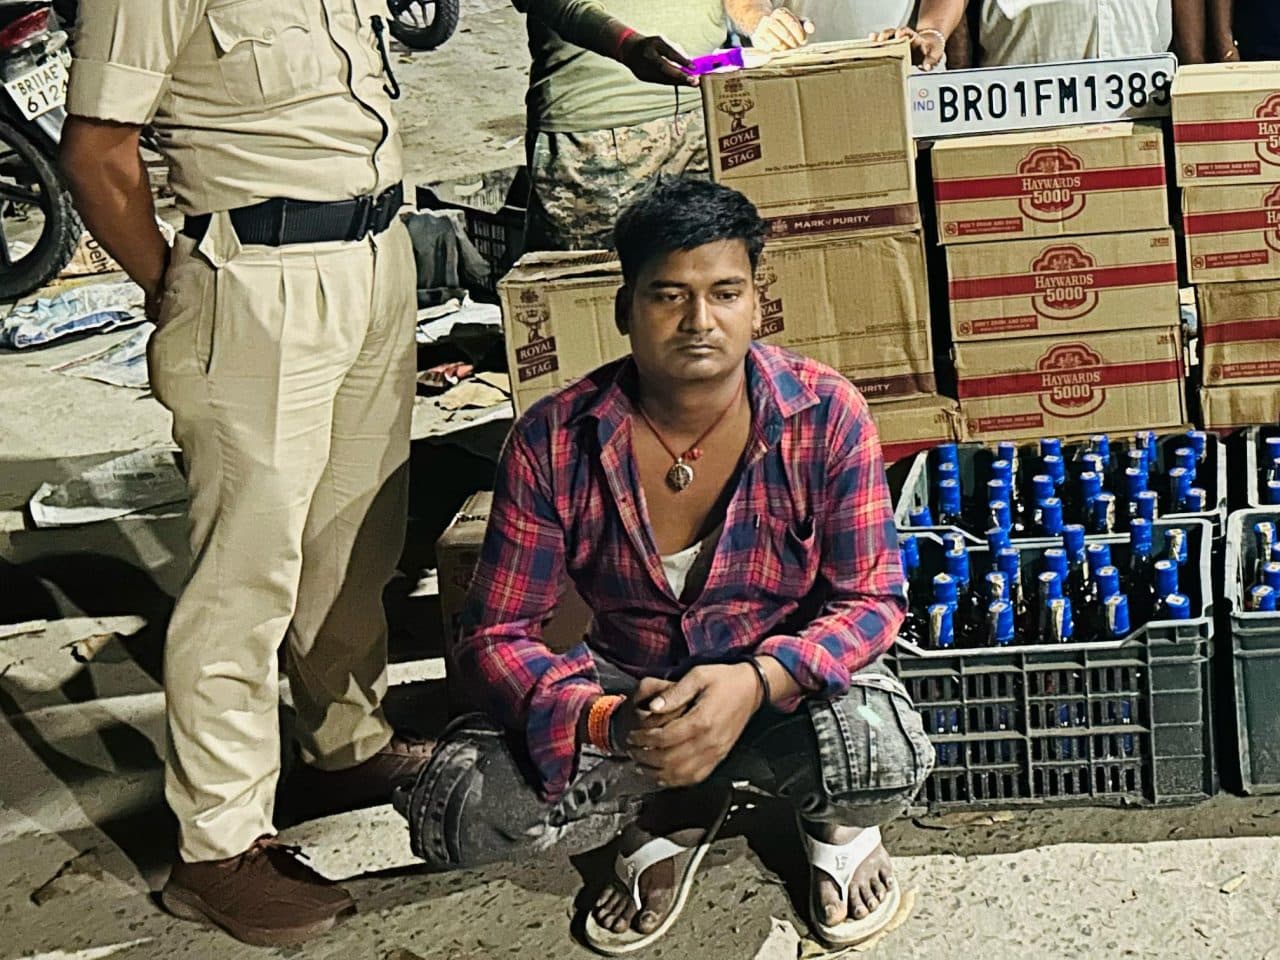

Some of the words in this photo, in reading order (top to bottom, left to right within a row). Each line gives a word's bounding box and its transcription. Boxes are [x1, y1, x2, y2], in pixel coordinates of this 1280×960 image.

[938, 70, 1171, 123] BR01FM1389
[913, 99, 935, 112] IND
[723, 129, 756, 149] ROYAL
[727, 150, 754, 166] STAG
[1022, 176, 1081, 191] HAYWARDS
[1033, 189, 1071, 204] 5000
[794, 219, 825, 230] MARK
[832, 215, 870, 226] PURITY
[1035, 274, 1094, 289] HAYWARDS
[1046, 287, 1083, 302] 5000
[520, 342, 553, 359] ROYAL
[525, 361, 552, 377] STAG
[1042, 371, 1100, 387] HAYWARDS
[857, 383, 890, 393] URITY
[1053, 384, 1090, 400] 5000
